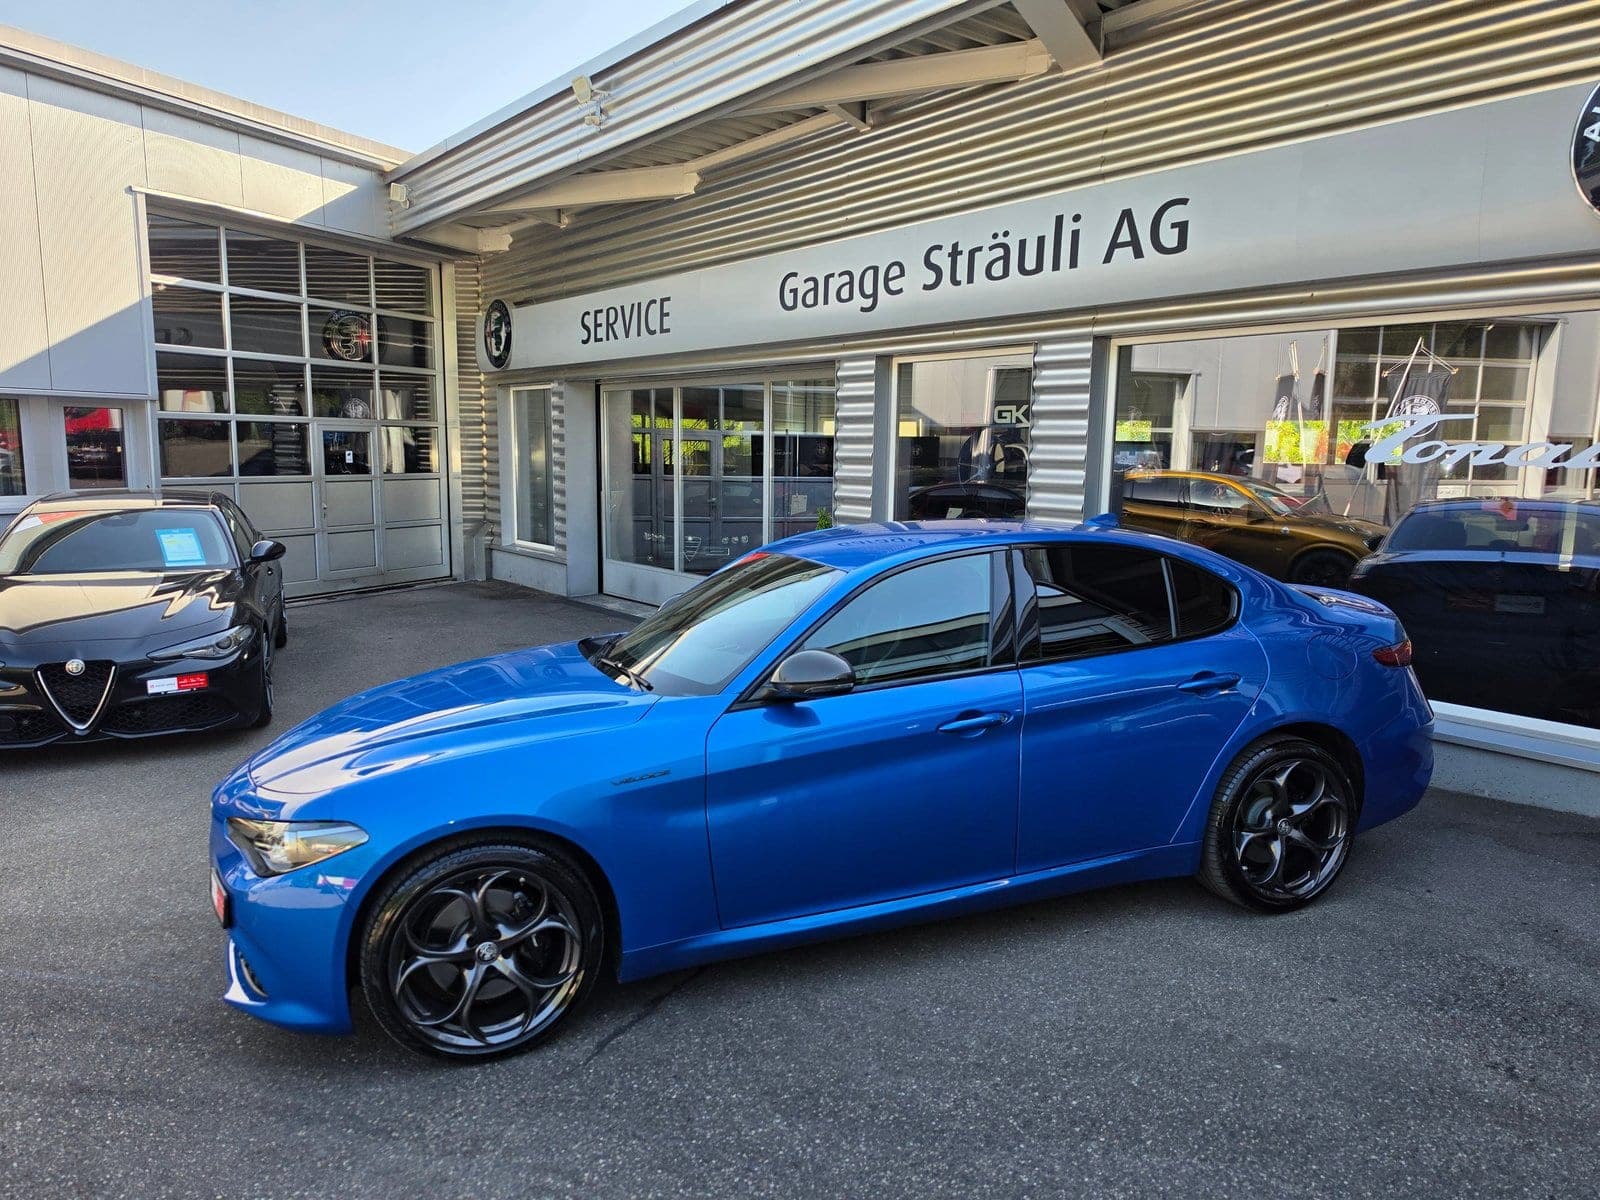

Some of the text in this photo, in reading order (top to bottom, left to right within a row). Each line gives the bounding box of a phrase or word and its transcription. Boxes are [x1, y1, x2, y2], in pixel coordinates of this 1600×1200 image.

[779, 197, 1190, 313] Garage Sträuli AG
[580, 296, 672, 345] SERVICE
[994, 405, 1030, 428] GK
